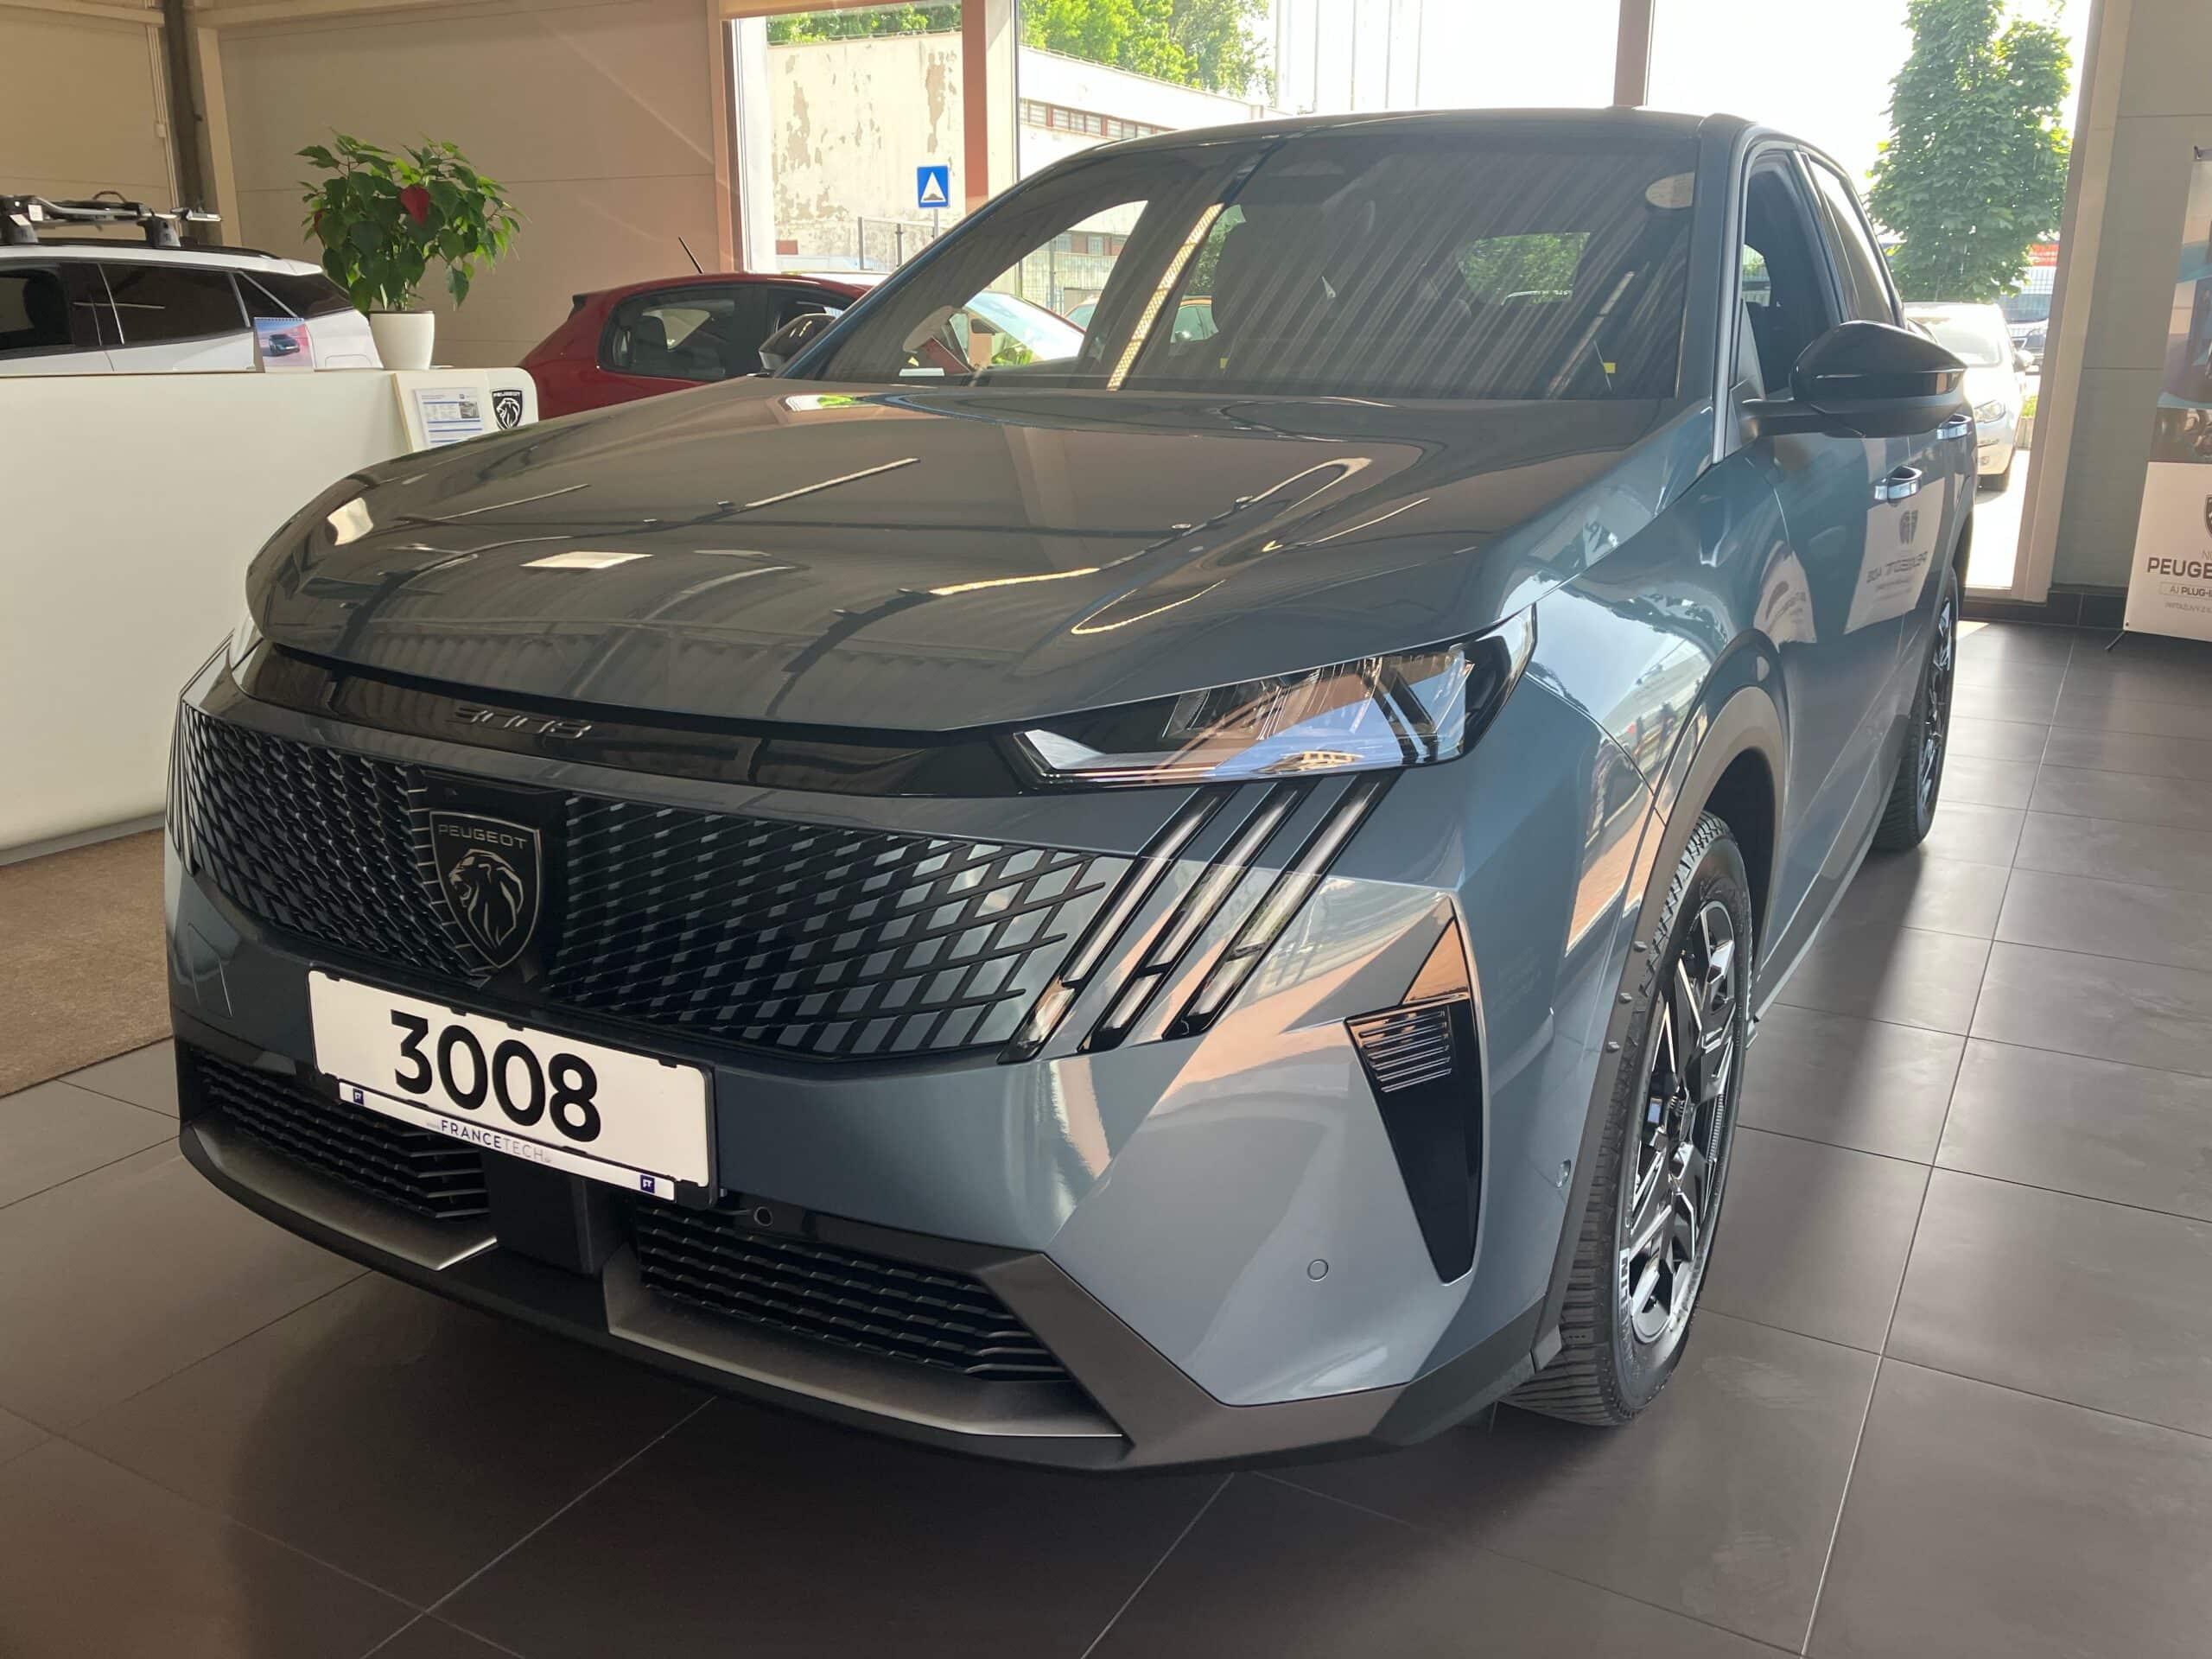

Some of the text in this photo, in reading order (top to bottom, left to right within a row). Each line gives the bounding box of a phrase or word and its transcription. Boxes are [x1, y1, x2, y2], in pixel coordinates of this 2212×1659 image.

[2147, 557, 2212, 579] PEUGE
[438, 823, 529, 850] PEUGEOT
[391, 1009, 601, 1143] 3008
